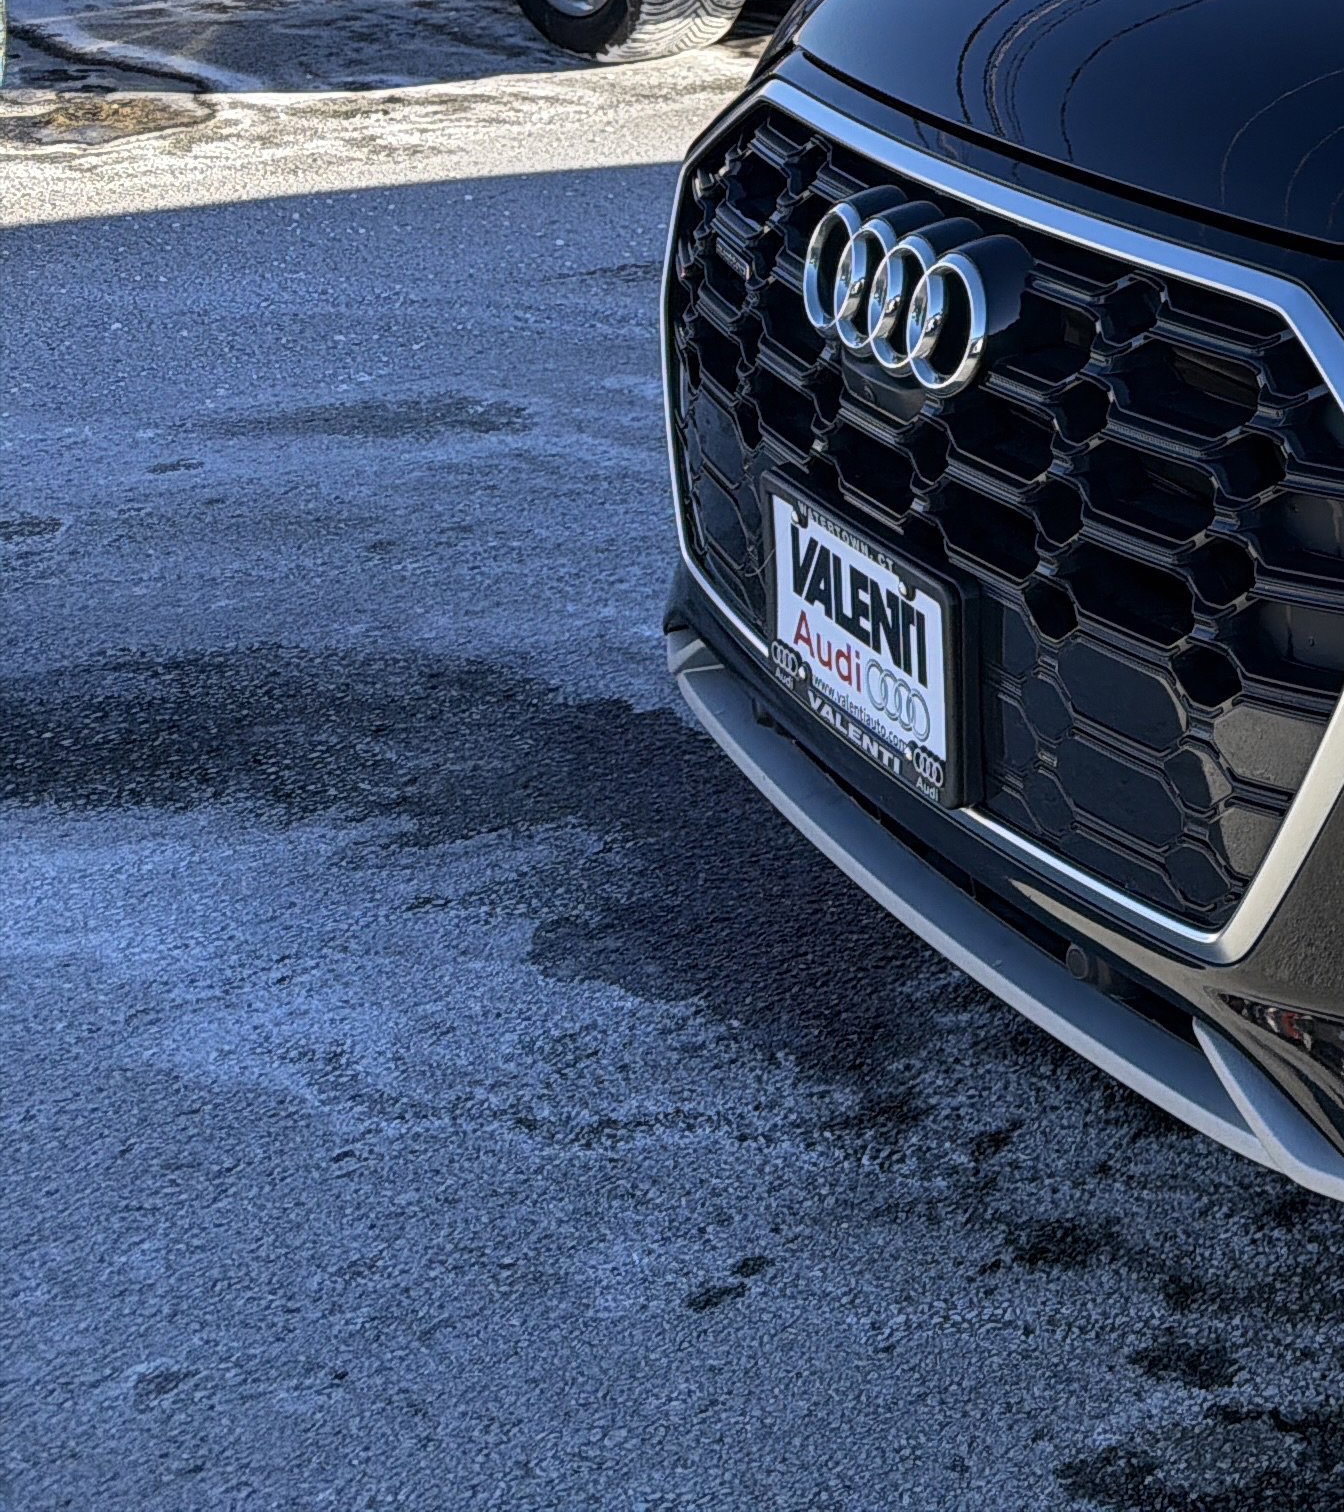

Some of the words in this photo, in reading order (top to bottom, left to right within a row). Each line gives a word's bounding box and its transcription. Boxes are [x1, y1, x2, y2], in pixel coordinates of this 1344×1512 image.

[797, 501, 874, 560] WATERTOWN,
[877, 553, 895, 571] CT
[791, 523, 928, 689] VALENTI
[775, 667, 794, 689] Audi
[793, 609, 861, 693] Audi
[807, 689, 900, 775] VALENTI
[916, 776, 939, 801] Audi
